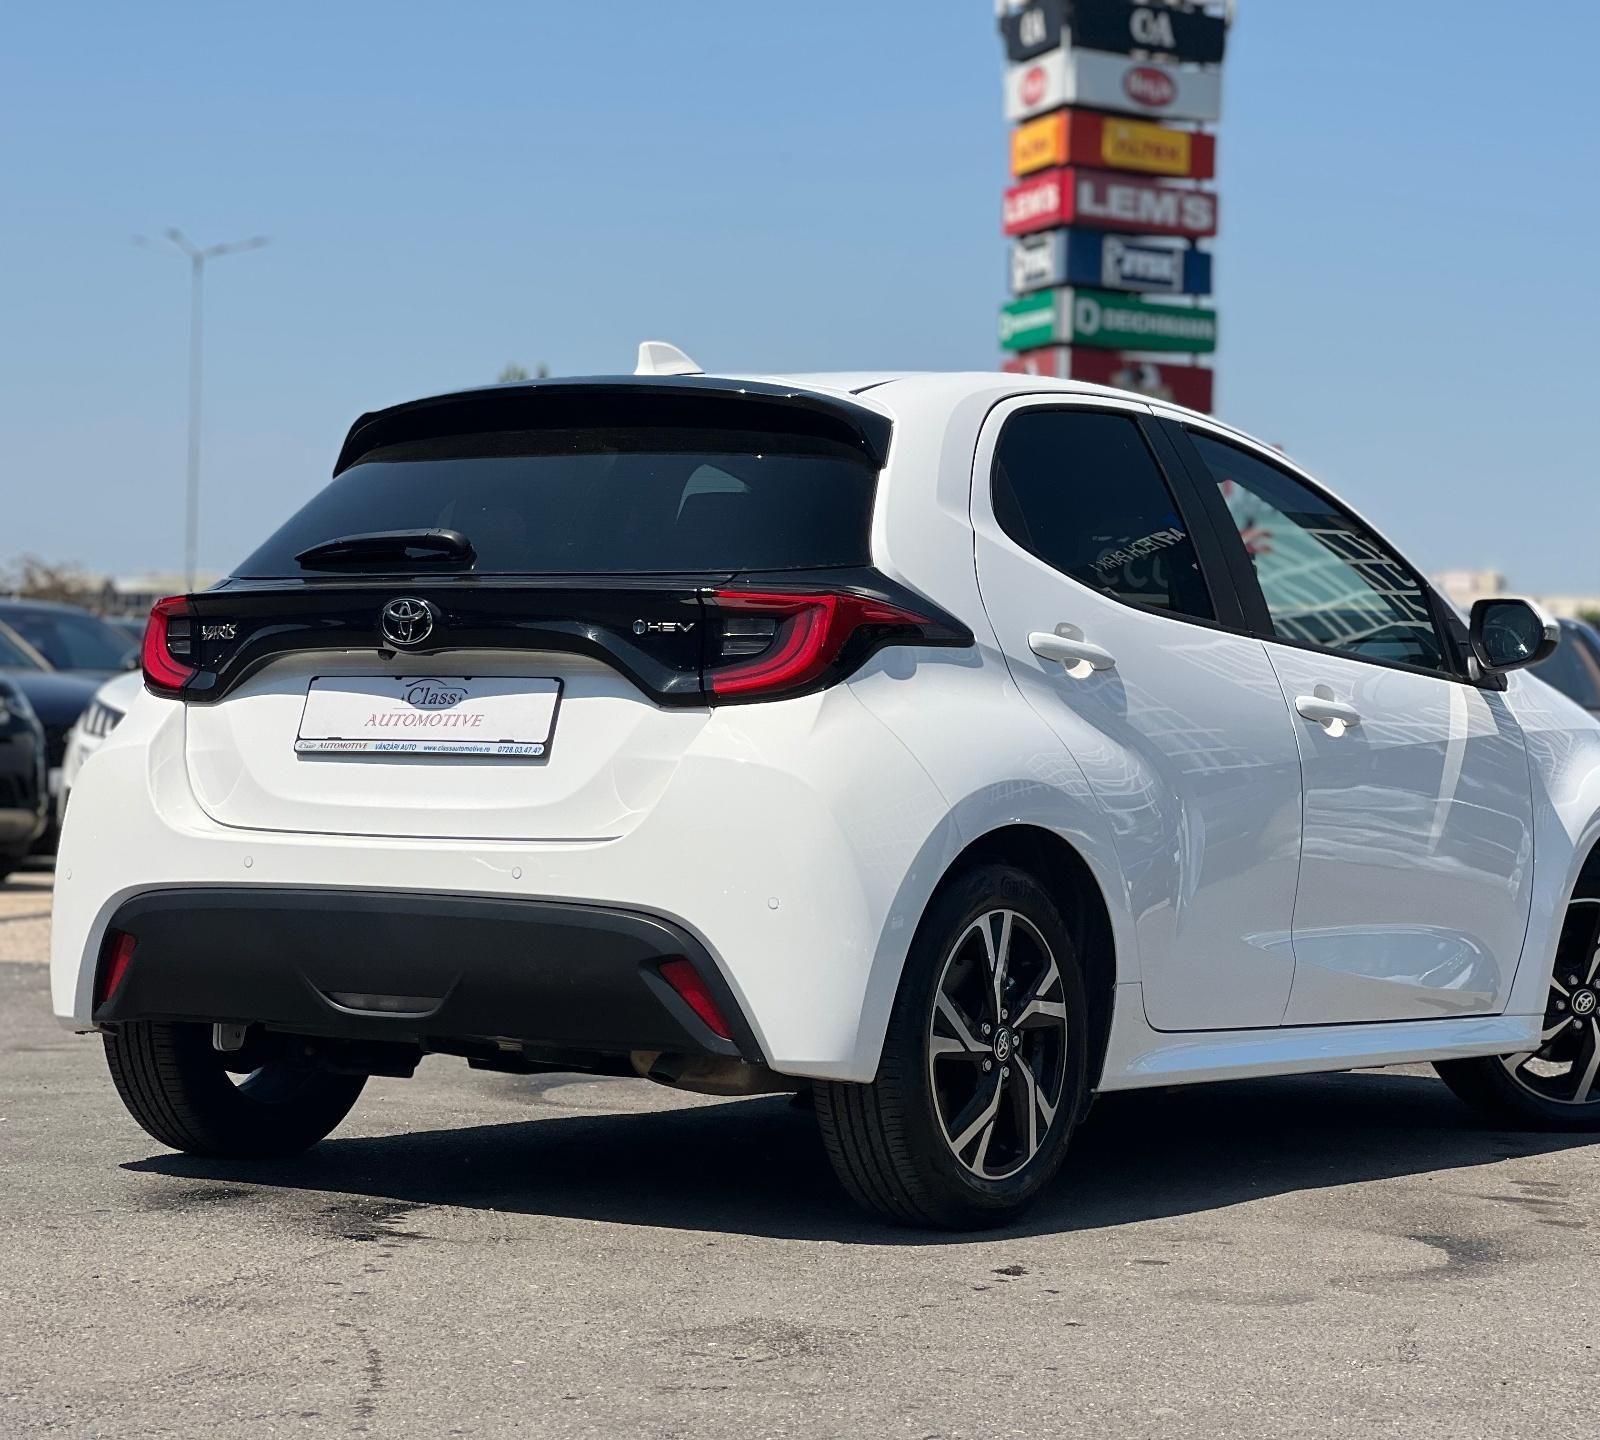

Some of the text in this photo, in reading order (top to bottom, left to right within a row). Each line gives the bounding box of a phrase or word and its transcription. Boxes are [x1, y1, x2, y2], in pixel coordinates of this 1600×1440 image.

[647, 622, 695, 632] HEV
[407, 687, 458, 705] Class
[364, 713, 484, 727] AUTOMOTIVE
